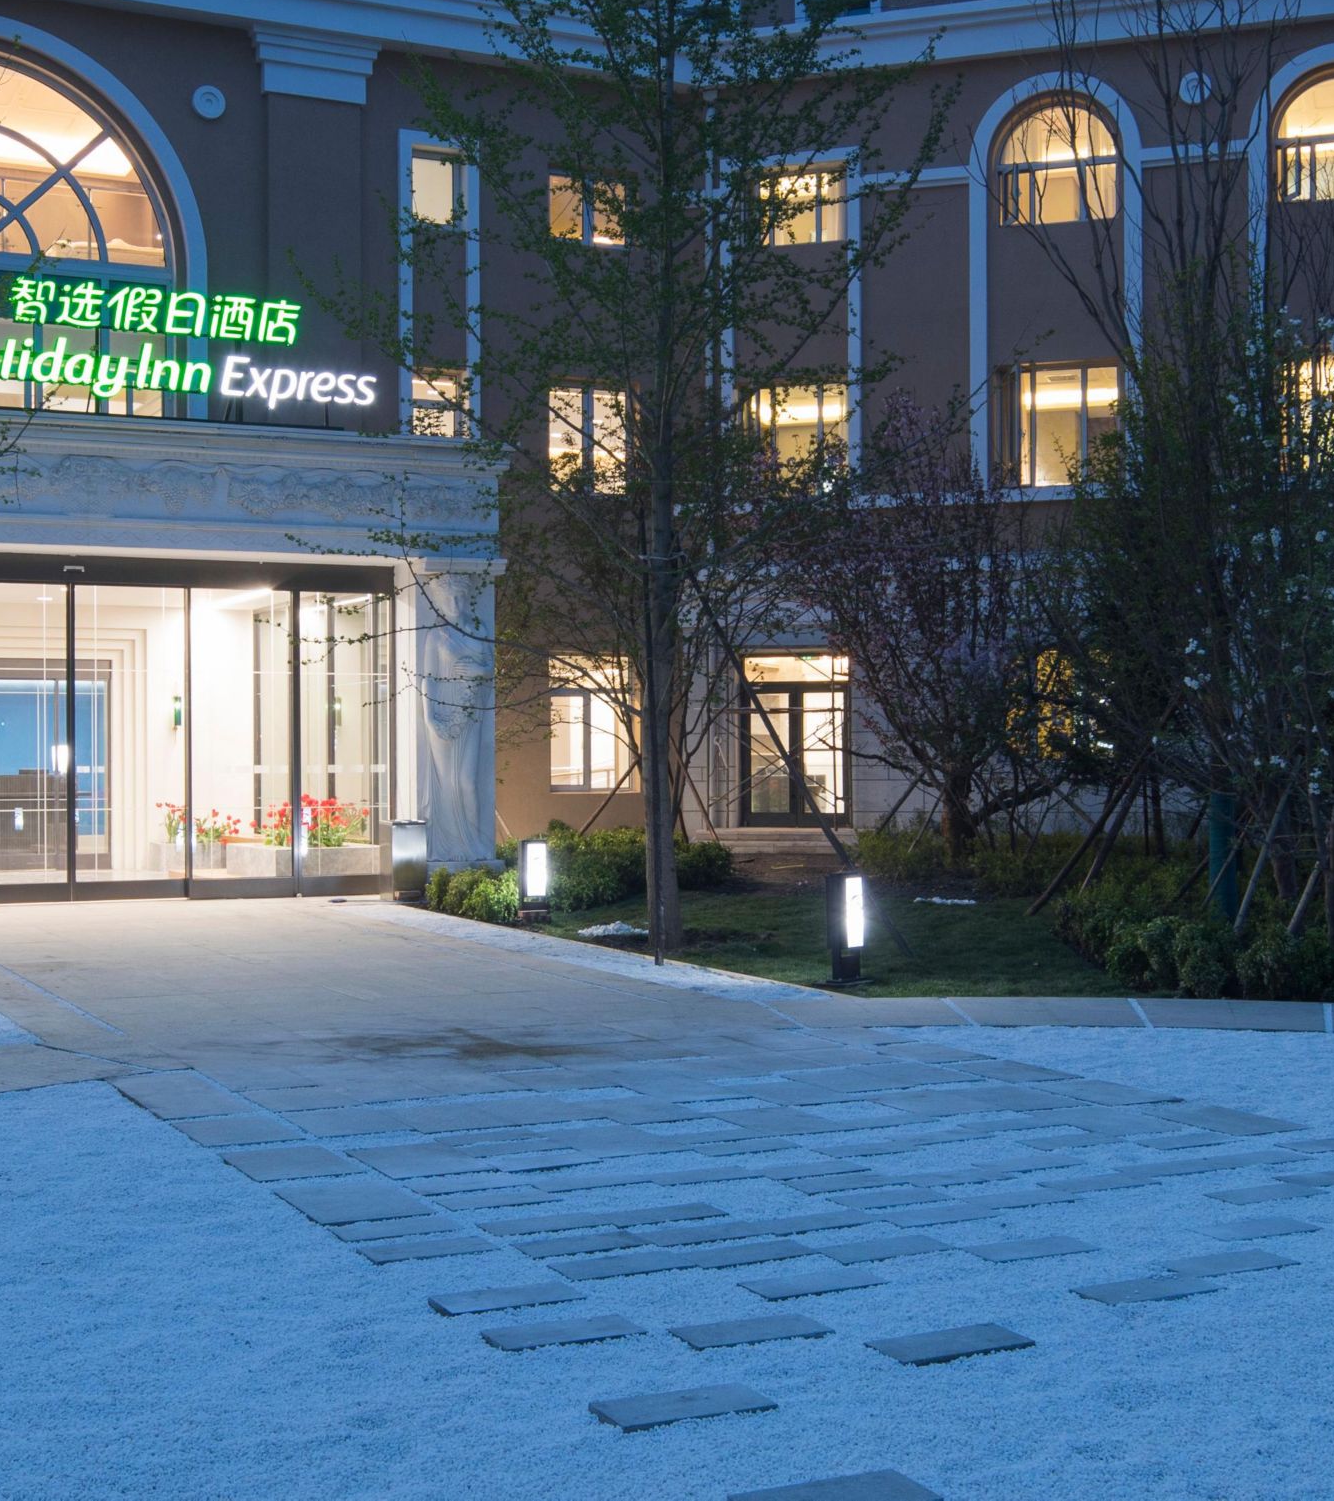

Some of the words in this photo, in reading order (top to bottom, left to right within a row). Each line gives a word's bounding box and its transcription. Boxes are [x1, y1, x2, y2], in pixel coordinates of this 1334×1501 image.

[10, 276, 301, 345] 智选假日酒店
[137, 342, 213, 393] Inn
[220, 354, 378, 410] Express
